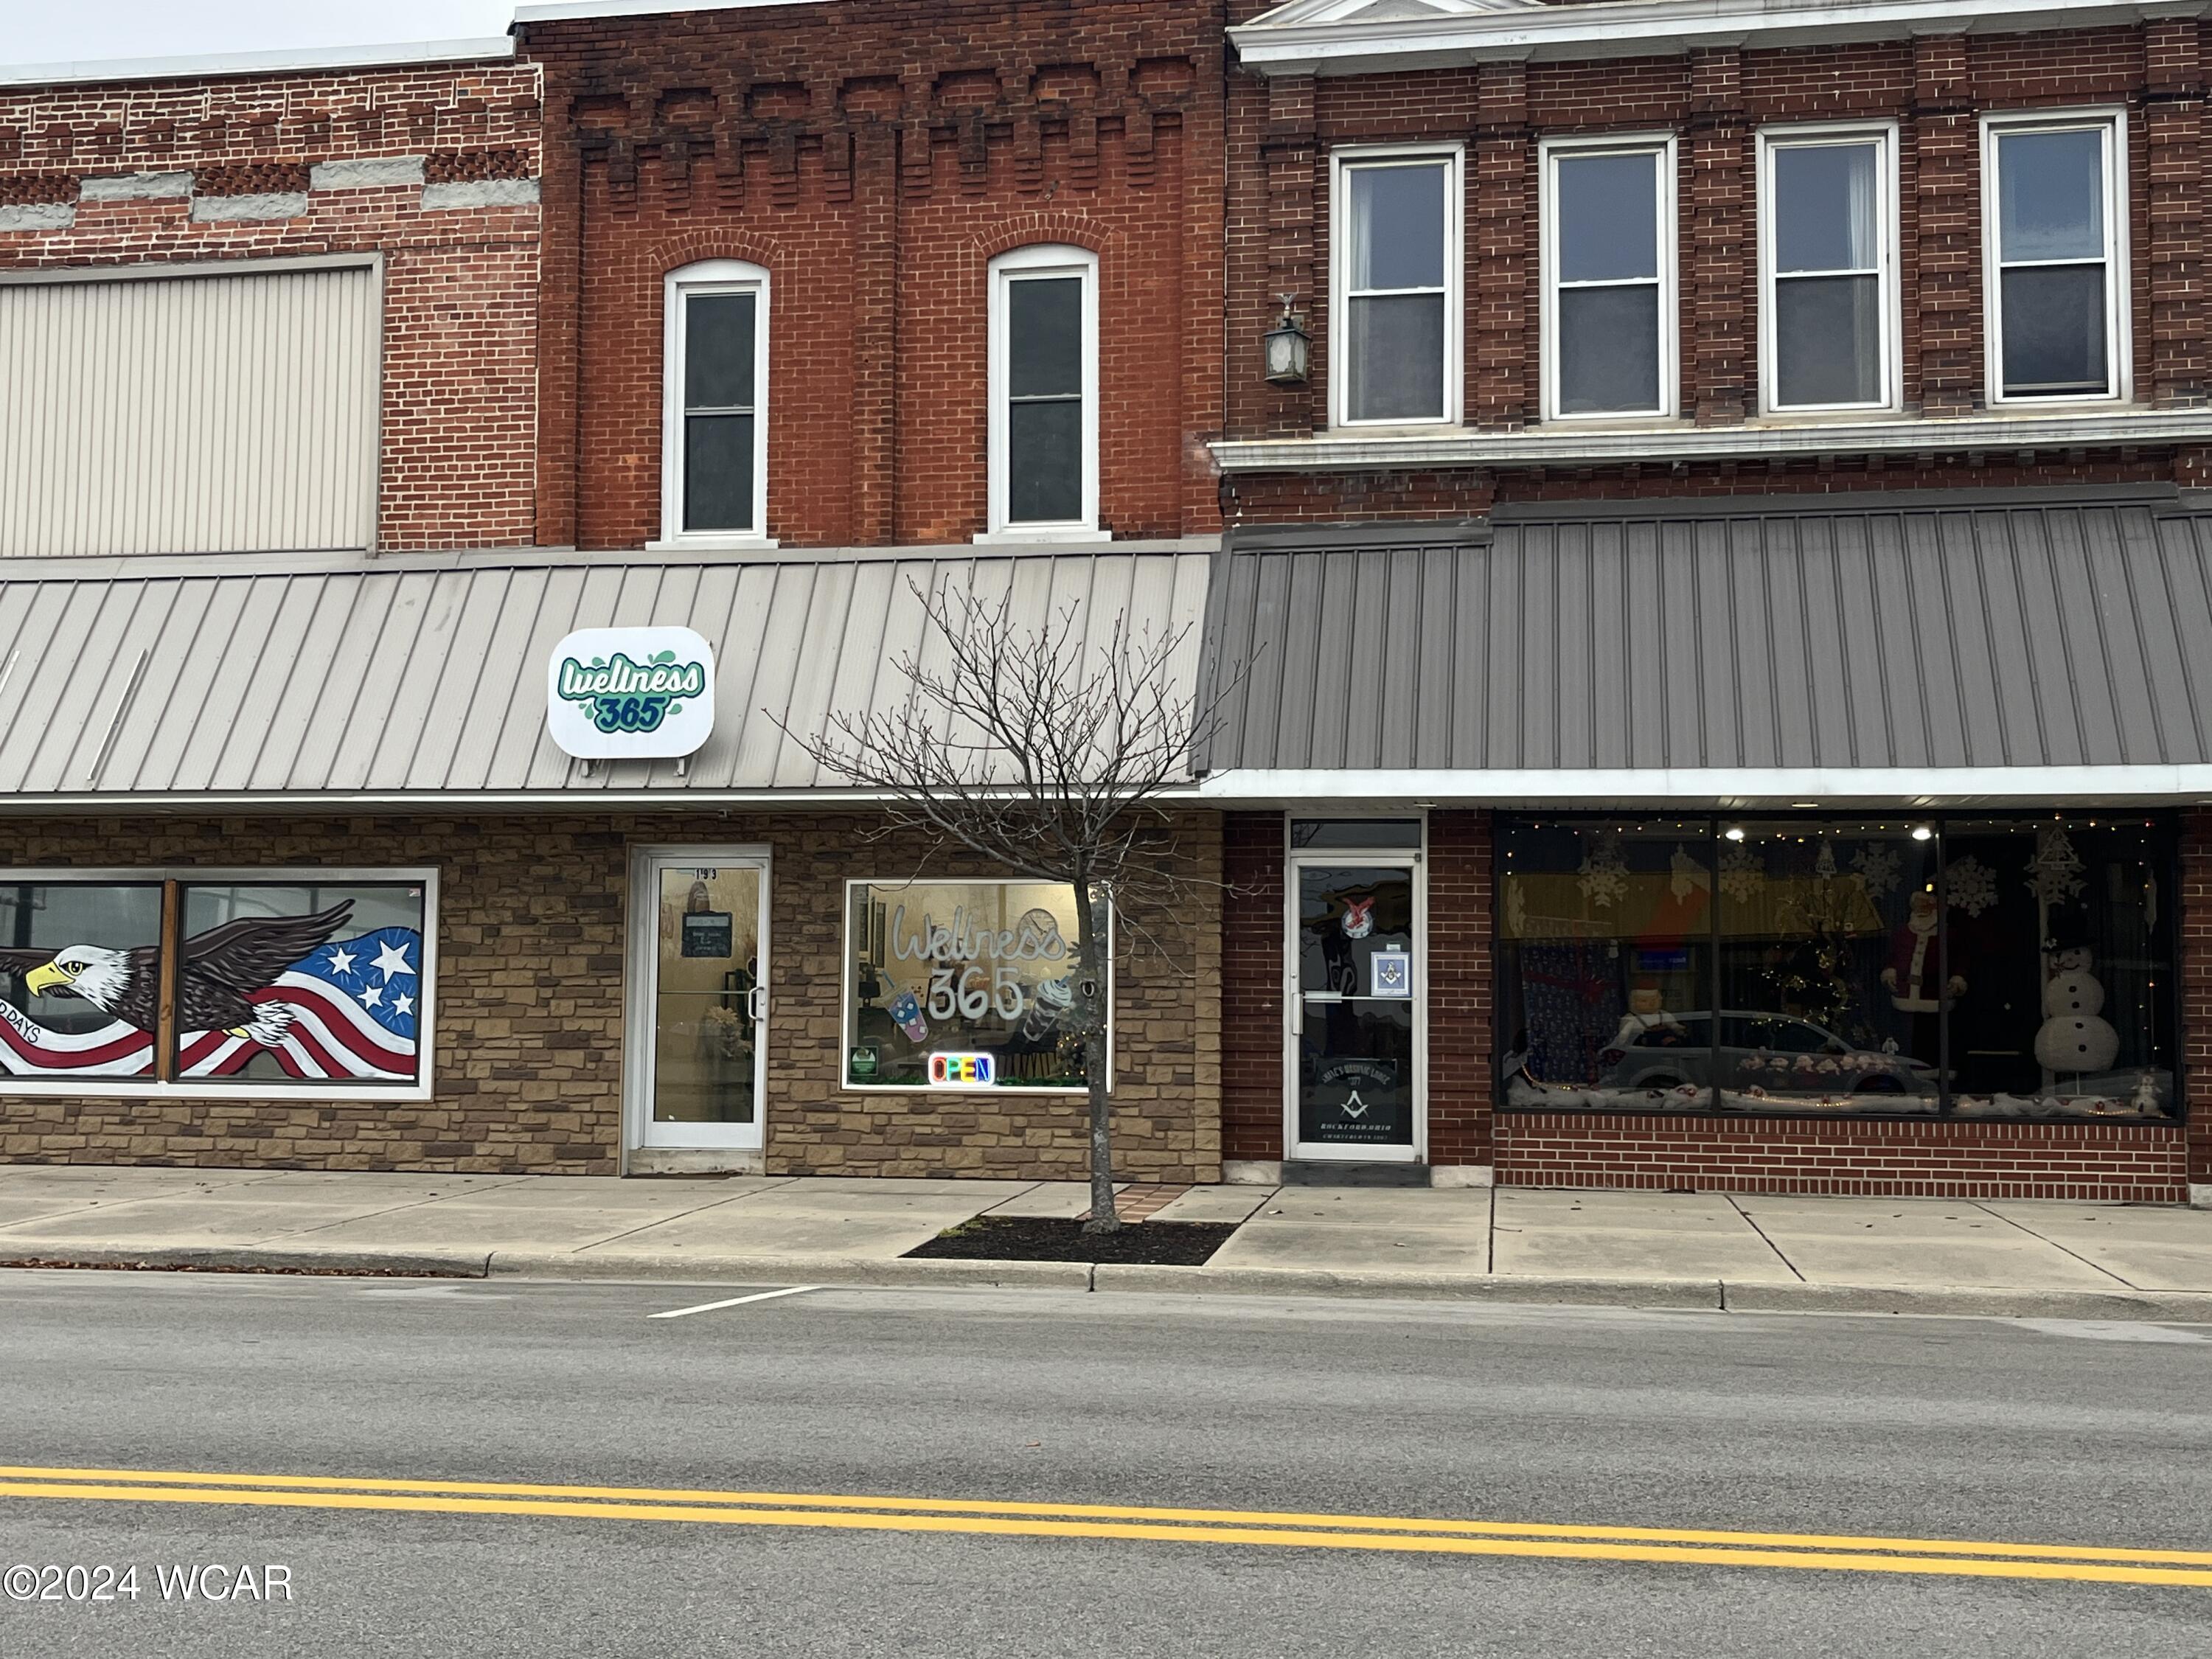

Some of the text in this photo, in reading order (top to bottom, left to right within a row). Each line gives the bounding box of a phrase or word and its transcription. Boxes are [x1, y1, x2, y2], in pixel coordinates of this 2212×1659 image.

[599, 698, 666, 728] 365
[696, 868, 717, 880] 193
[892, 905, 1066, 961] Wellness
[928, 967, 1023, 1020] 365
[7, 1009, 41, 1043] DAYS
[931, 1057, 992, 1082] OPEN
